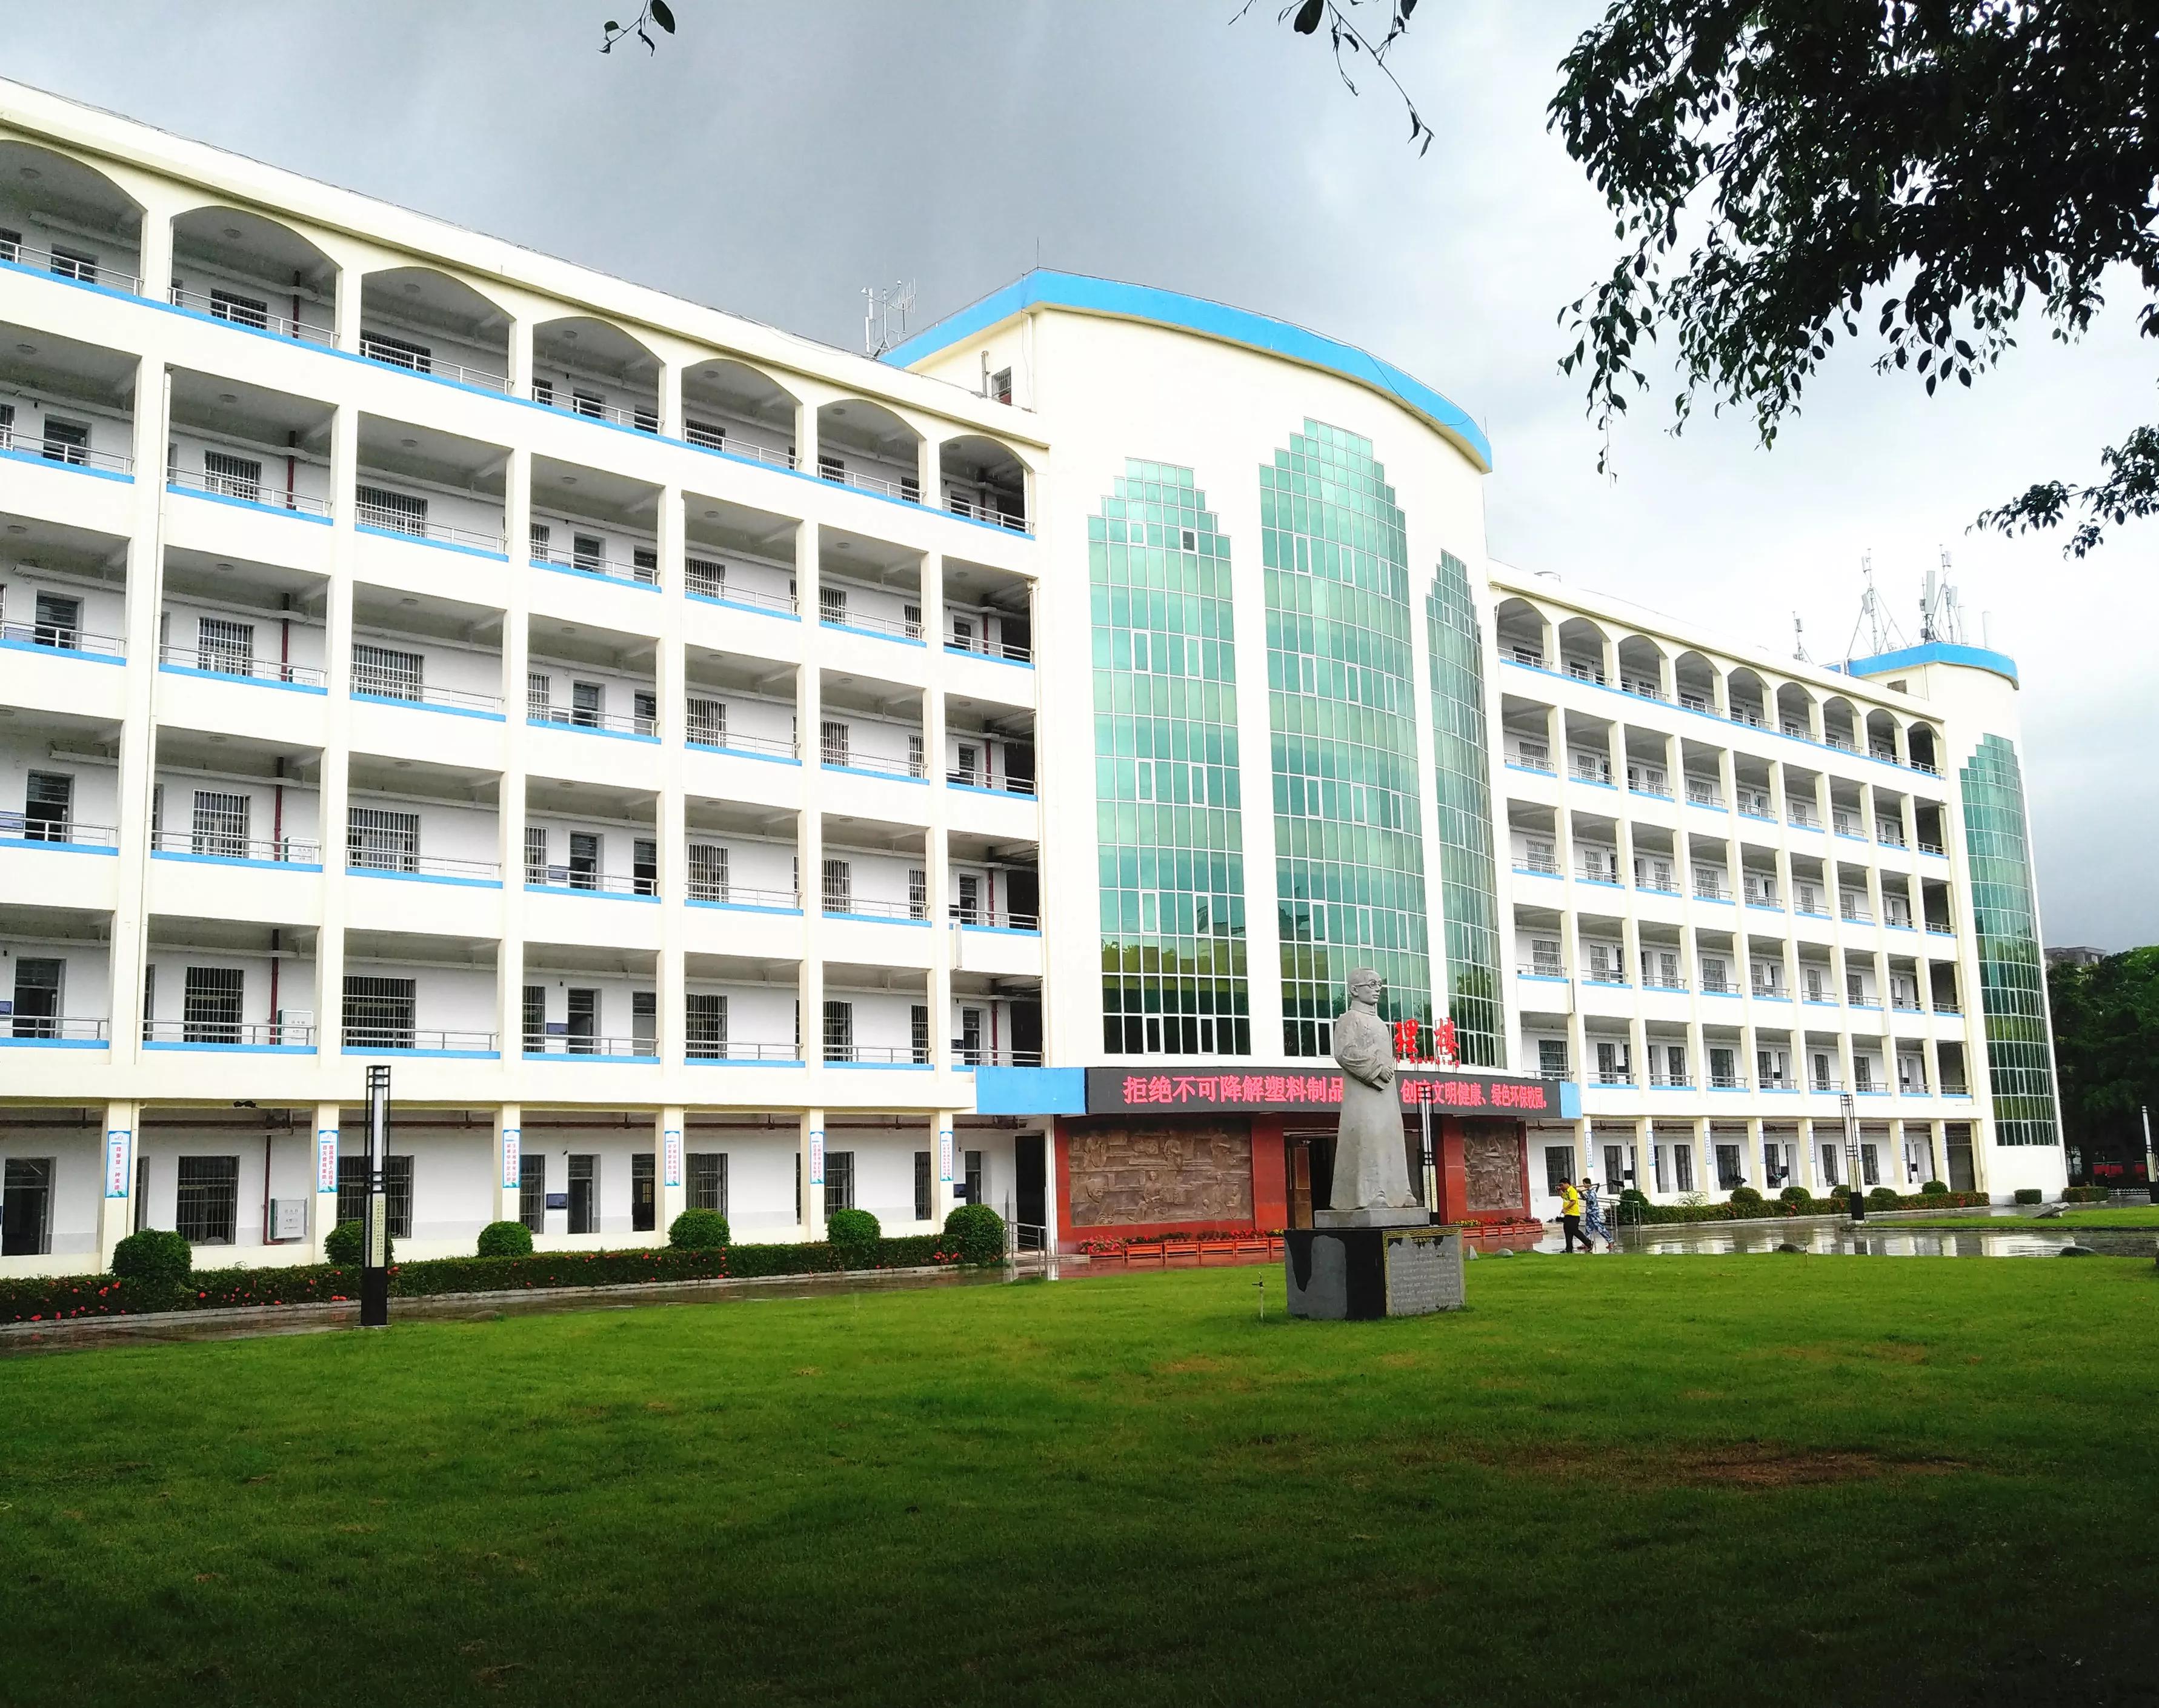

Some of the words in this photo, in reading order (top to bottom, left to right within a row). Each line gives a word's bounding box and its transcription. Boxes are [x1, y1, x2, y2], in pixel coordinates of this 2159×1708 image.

[1122, 1075, 1344, 1103] 拒绝不可降解塑料制品
